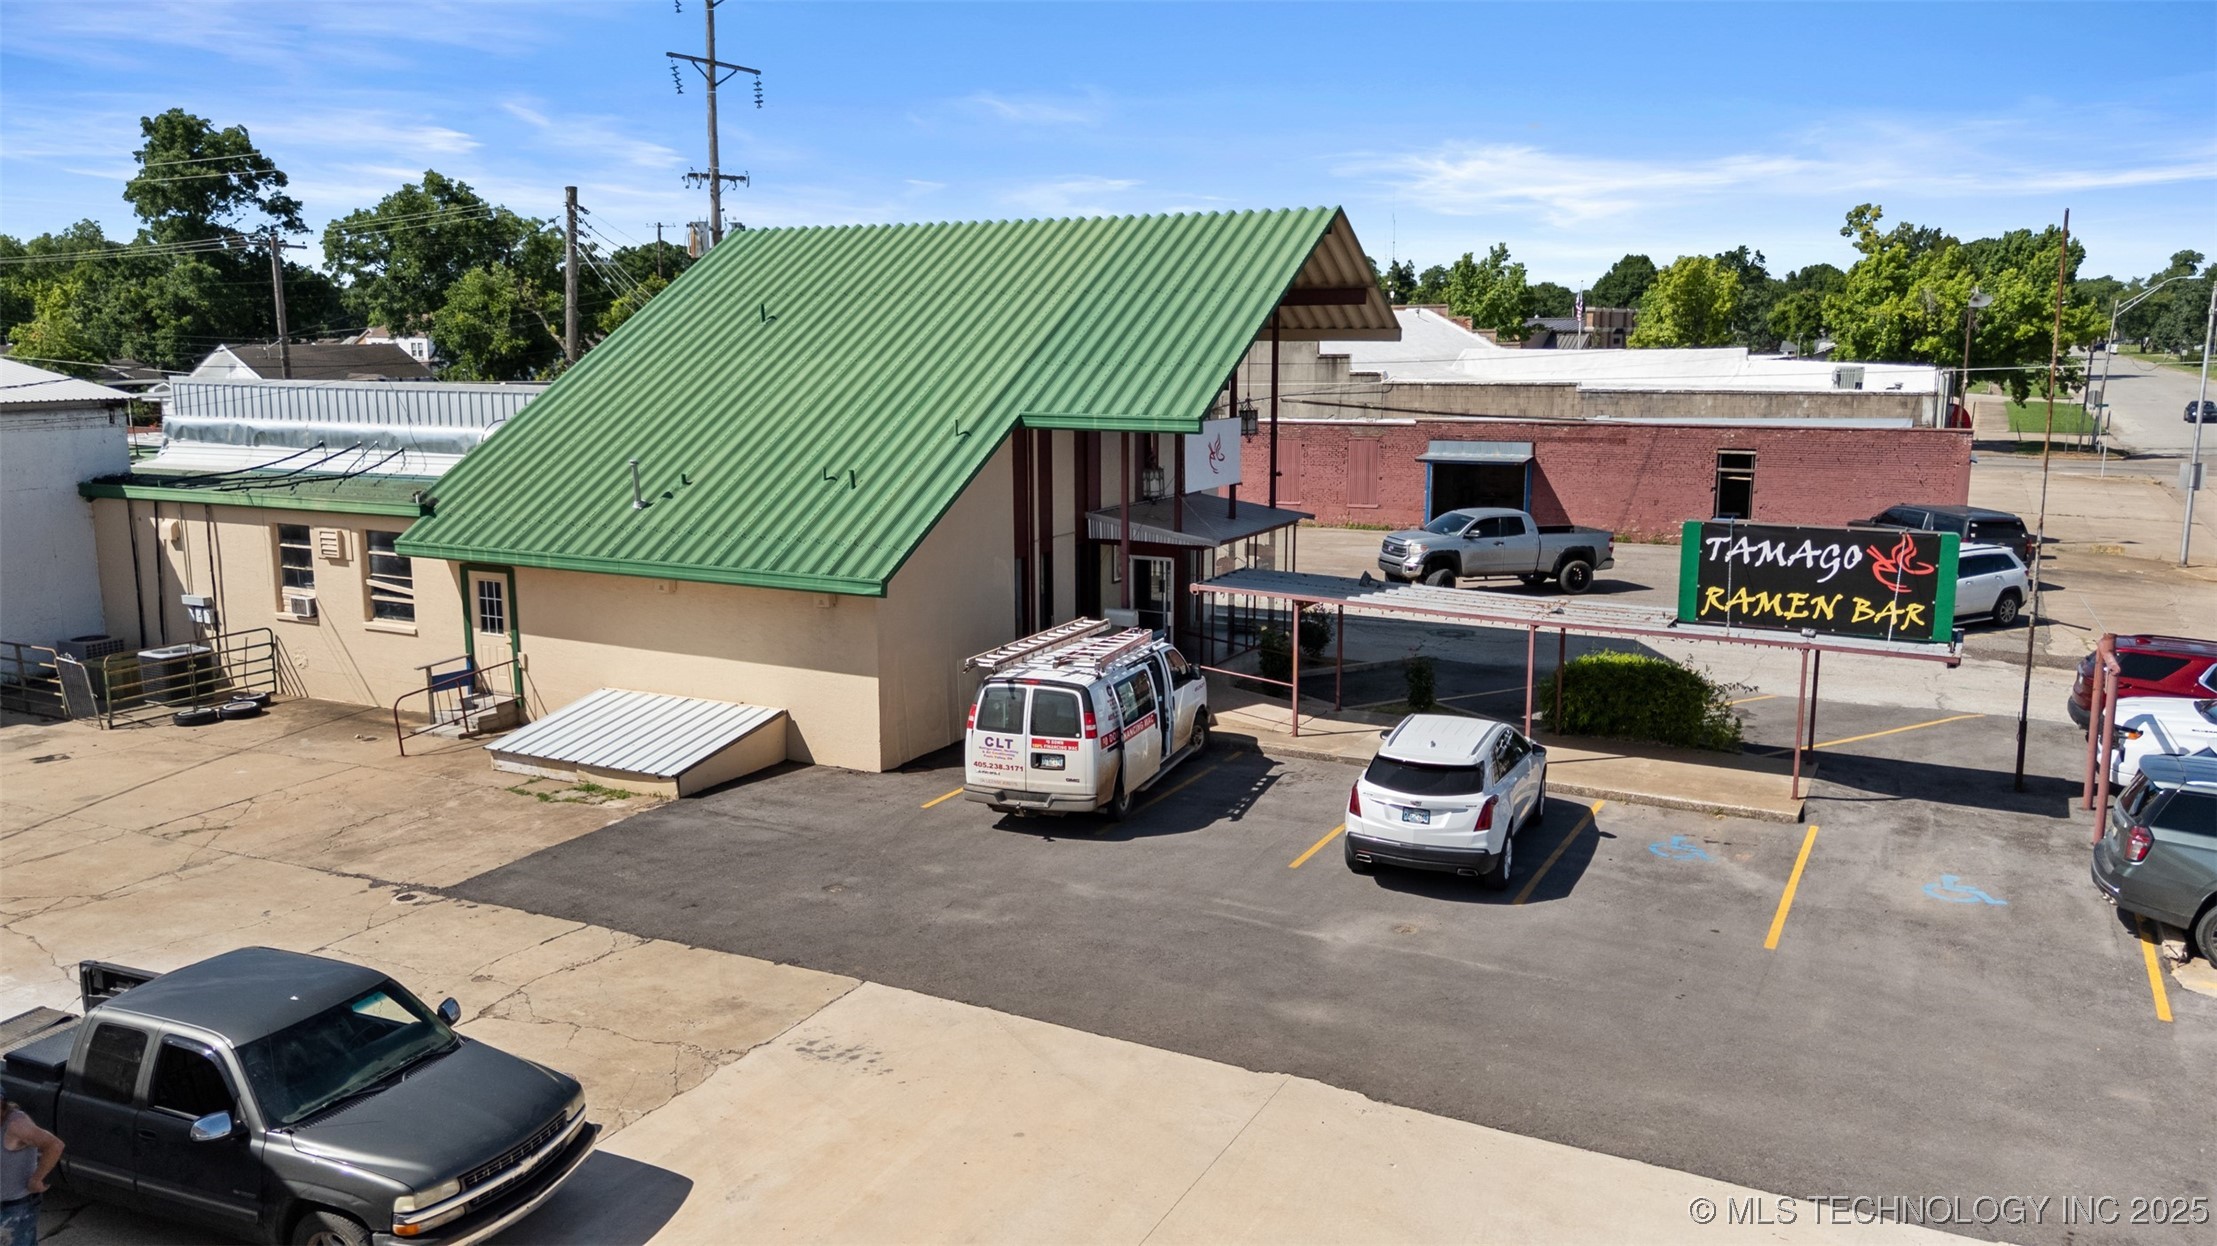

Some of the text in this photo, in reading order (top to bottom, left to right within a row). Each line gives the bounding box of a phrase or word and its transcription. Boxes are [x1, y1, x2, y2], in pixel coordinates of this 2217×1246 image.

[1705, 536, 1863, 583] TAMAGO
[1700, 586, 1926, 631] RAMEN BAR
[984, 736, 1014, 749] CLT
[973, 761, 1024, 772] 405.238.3171
